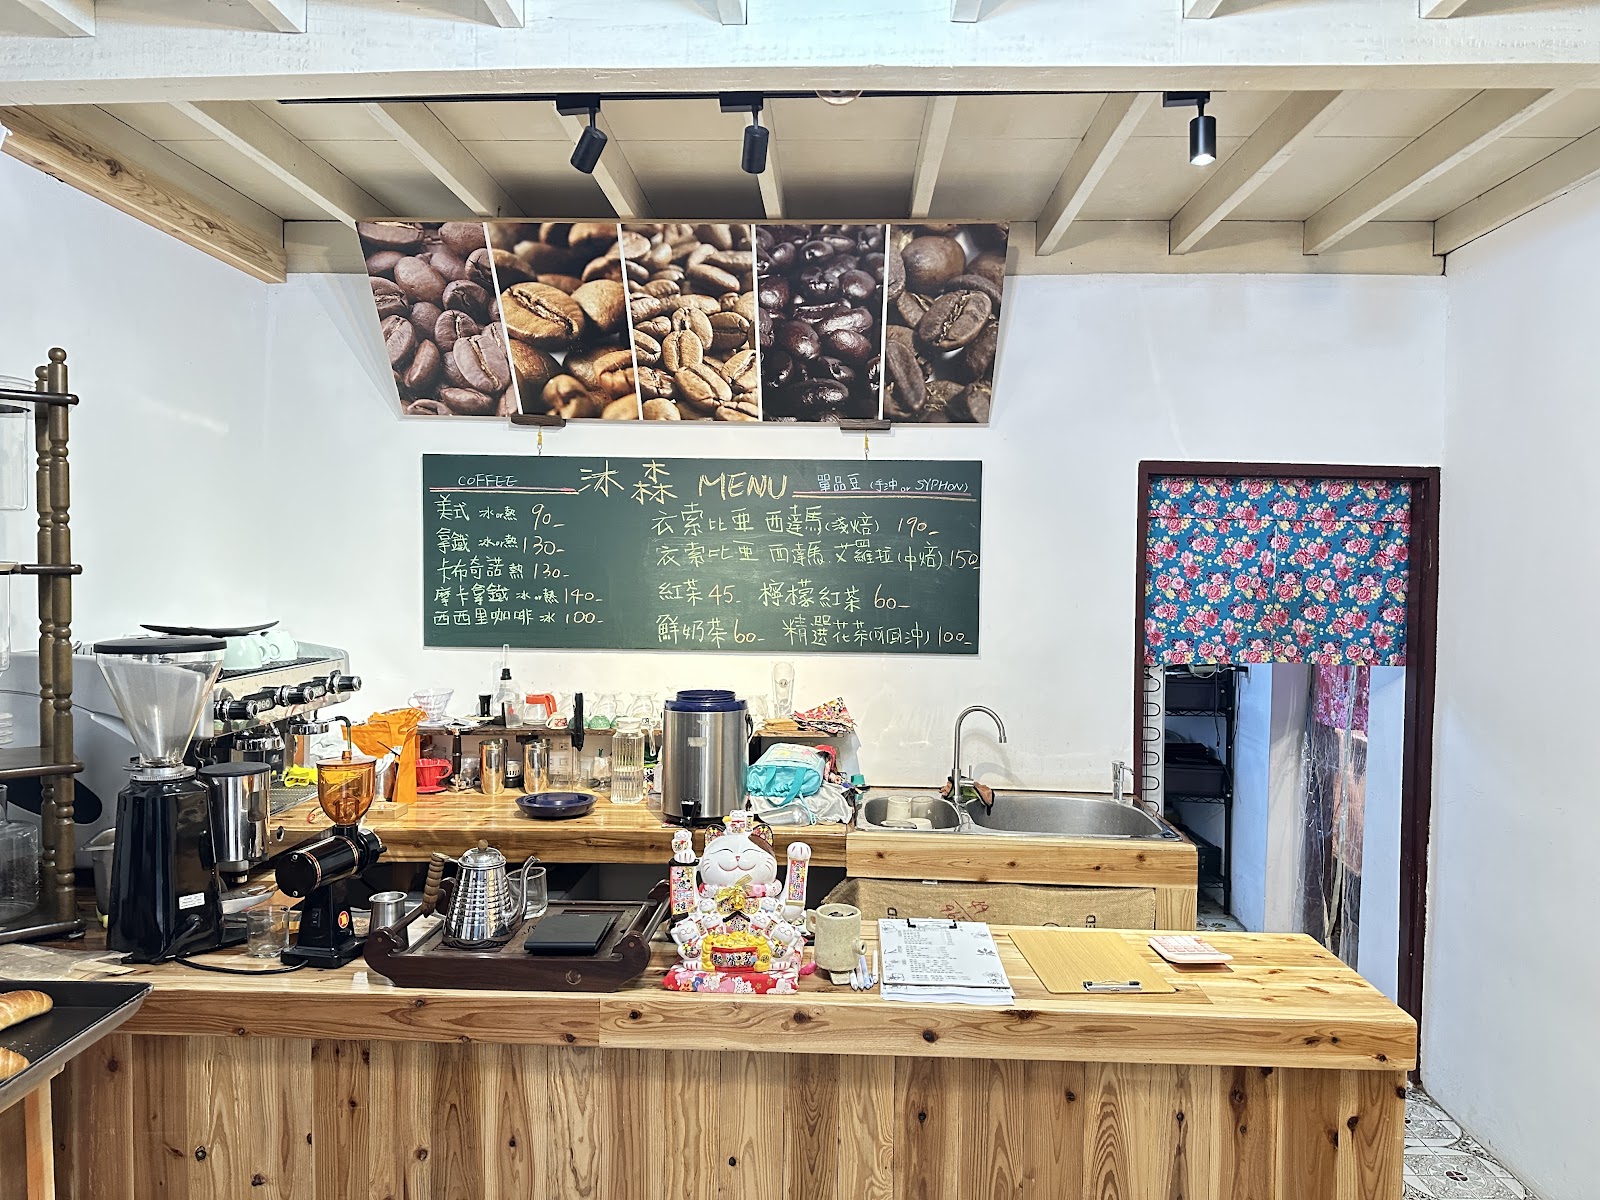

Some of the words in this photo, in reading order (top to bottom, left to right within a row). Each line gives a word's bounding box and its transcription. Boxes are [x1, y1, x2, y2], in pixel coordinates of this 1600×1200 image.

[457, 473, 518, 487] COFFEE
[699, 471, 788, 500] MENU
[817, 473, 862, 492] 單品豆
[434, 494, 470, 521] 美式
[436, 527, 471, 554] 拿鐵
[436, 555, 505, 583] 卡布奇諾
[508, 563, 524, 579] 熱
[433, 582, 510, 607] 摩卡拿鐵
[658, 578, 703, 607] 紅茶
[758, 578, 862, 613] 檸檬紅茶
[433, 607, 534, 626] 西西里咖啡
[539, 612, 556, 624] 冰
[655, 614, 728, 649] 鮮奶茶
